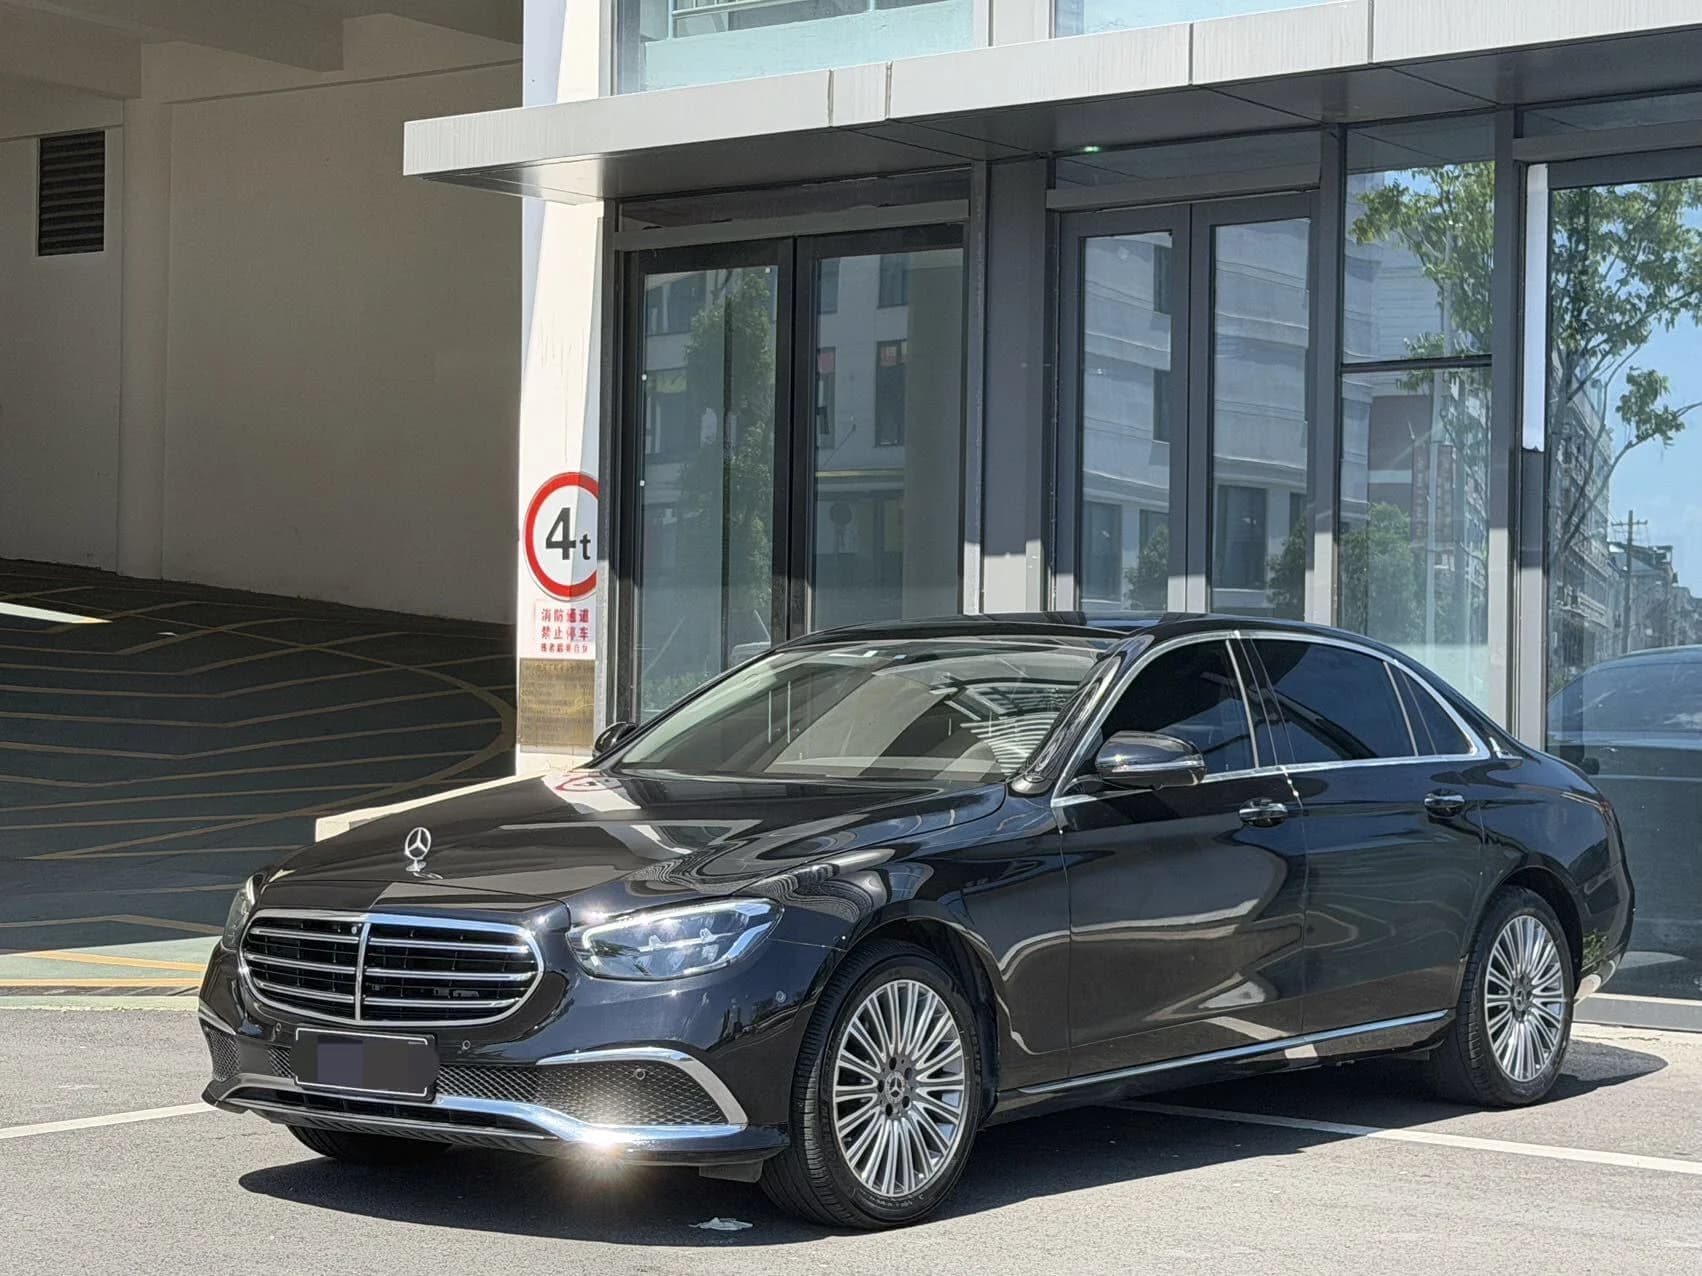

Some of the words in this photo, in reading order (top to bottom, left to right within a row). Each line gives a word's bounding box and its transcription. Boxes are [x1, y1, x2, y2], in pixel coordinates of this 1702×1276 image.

[541, 608, 589, 623] 消防通道
[541, 626, 589, 640] 禁止停车
